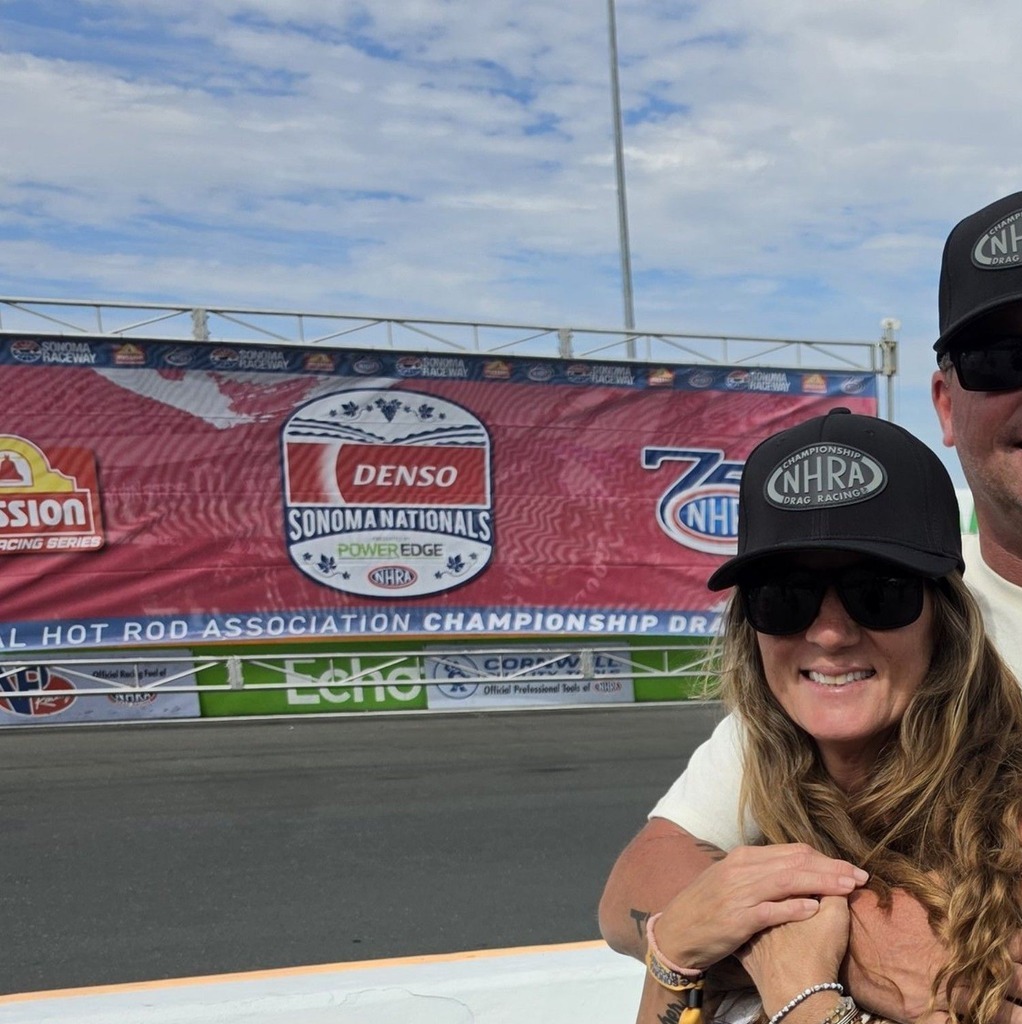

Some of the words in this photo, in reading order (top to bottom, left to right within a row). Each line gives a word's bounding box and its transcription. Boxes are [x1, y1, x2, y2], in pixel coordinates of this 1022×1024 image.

[991, 254, 1020, 265] DRAG
[41, 341, 92, 353] SONOMA
[42, 352, 97, 364] RACEWAY
[782, 445, 862, 469] CHAMPIONSHIP
[353, 464, 458, 487] DENSO
[783, 456, 865, 494] NHRA
[783, 496, 812, 506] DRAG
[817, 488, 861, 503] RACING
[687, 496, 738, 535] NH
[288, 509, 377, 541] SONOMA
[380, 509, 492, 542] NATIONALS
[46, 536, 102, 549] SERIES
[338, 543, 400, 558] POWER
[400, 543, 444, 557] EDGE
[374, 568, 412, 586] NHRA
[0, 627, 26, 648] L
[42, 623, 109, 646] HOT
[123, 620, 188, 642] ROD
[202, 612, 411, 640] ASSOCIATION
[423, 612, 659, 632] CHAMPIONSHIP
[484, 655, 621, 671] CORNWLL
[285, 658, 422, 704] Echo
[484, 684, 511, 695] Official
[514, 682, 560, 694] Professional
[563, 682, 580, 693] Tools
[582, 682, 592, 692] of
